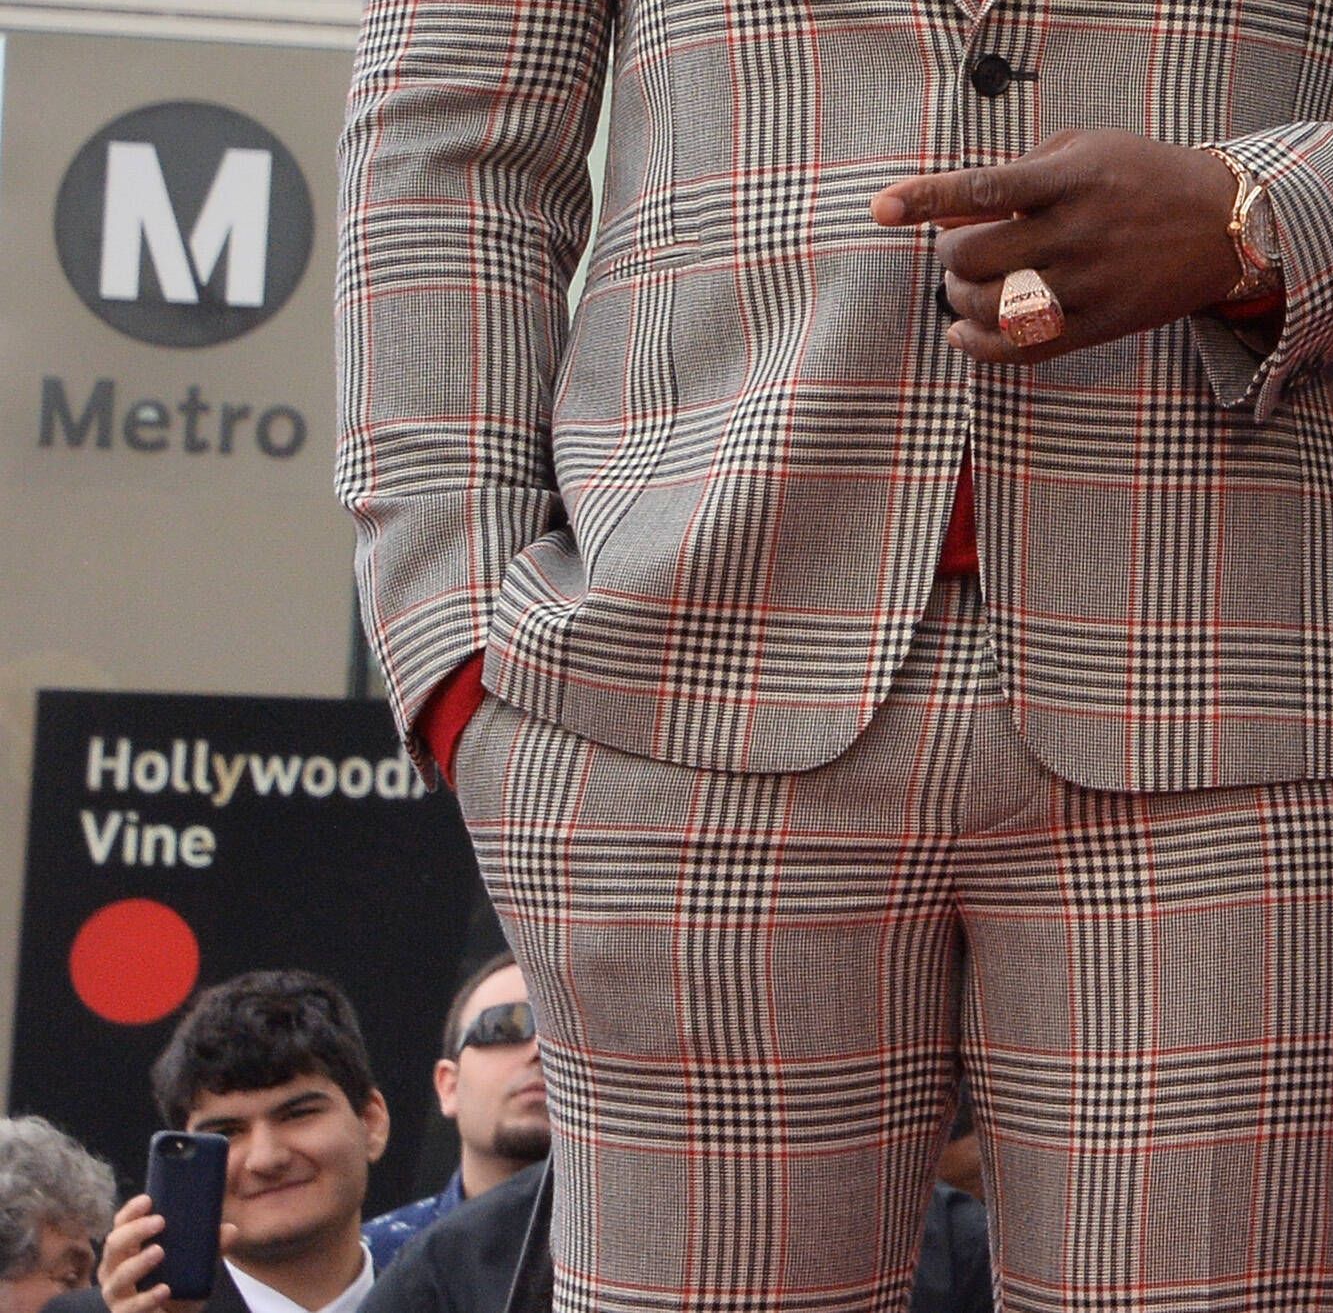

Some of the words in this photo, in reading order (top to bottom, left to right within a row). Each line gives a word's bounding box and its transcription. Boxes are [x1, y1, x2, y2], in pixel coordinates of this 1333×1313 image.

[99, 141, 272, 308] M
[37, 375, 307, 459] Metro
[80, 809, 217, 868] Vine
